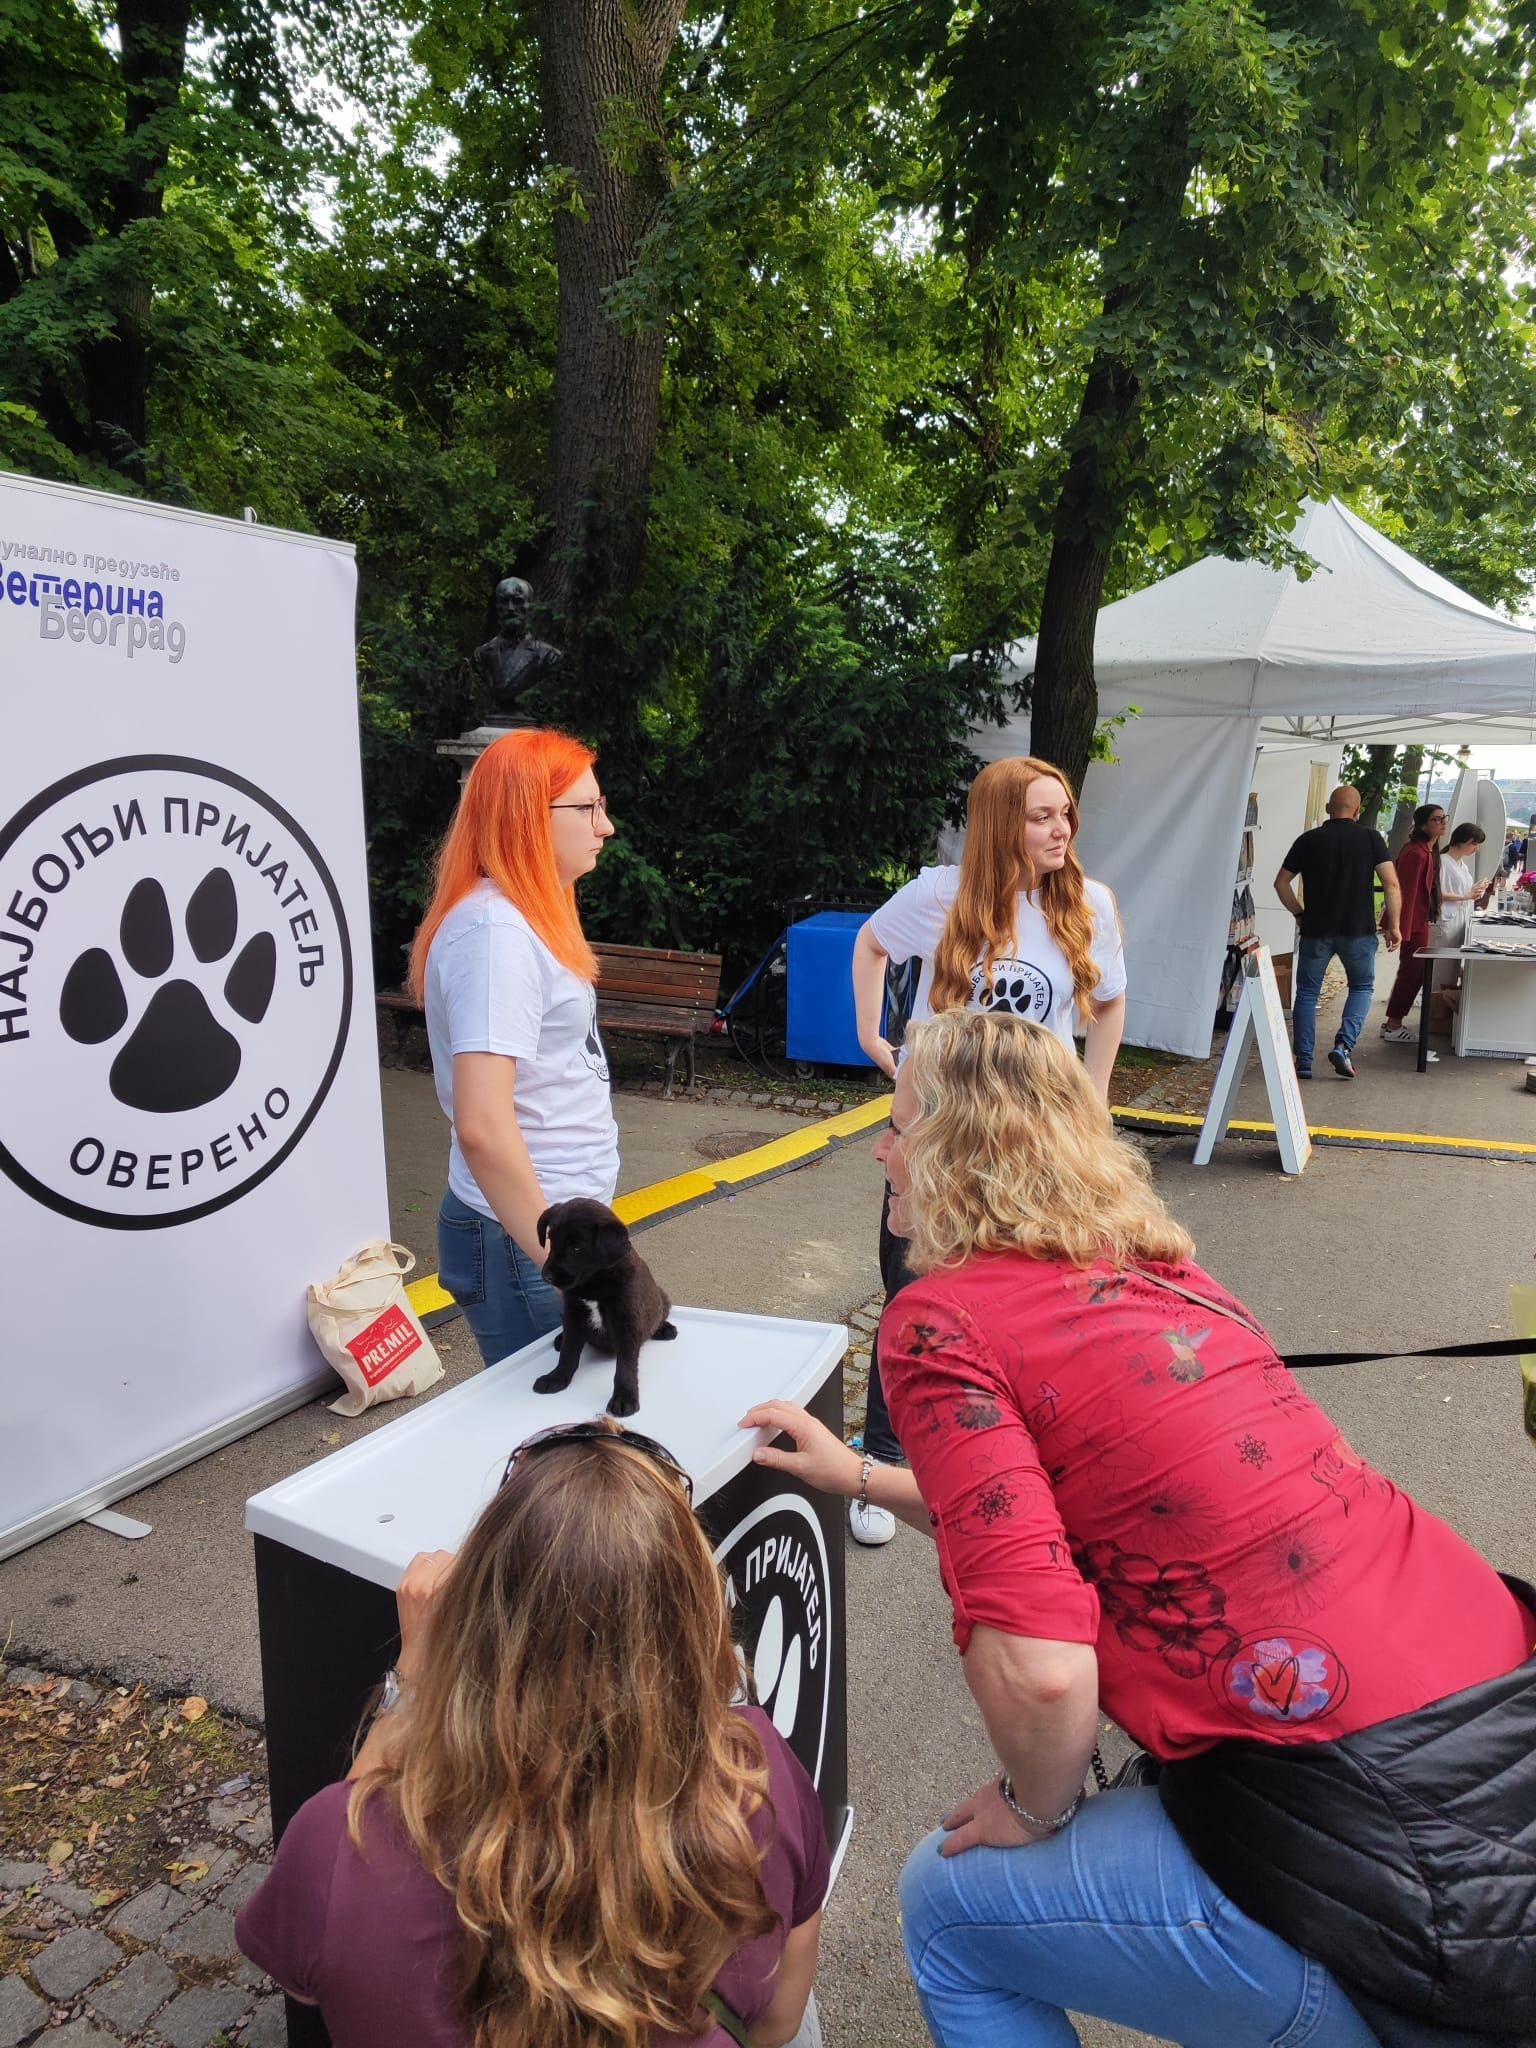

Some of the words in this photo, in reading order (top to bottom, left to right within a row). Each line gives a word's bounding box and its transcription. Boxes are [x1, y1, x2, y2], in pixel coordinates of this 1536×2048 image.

[0, 540, 77, 566] унално
[83, 554, 181, 582] предузеће
[0, 562, 164, 619] етерина
[39, 593, 186, 663] Београд
[0, 798, 147, 1044] НАЈБОЉИ
[163, 796, 325, 988] ПРИЈАТЕЉ
[69, 1087, 290, 1190] ОВЕРЕНО
[361, 1323, 414, 1373] PREMIL
[745, 1535, 821, 1671] ПРИЈАТЕЉ
